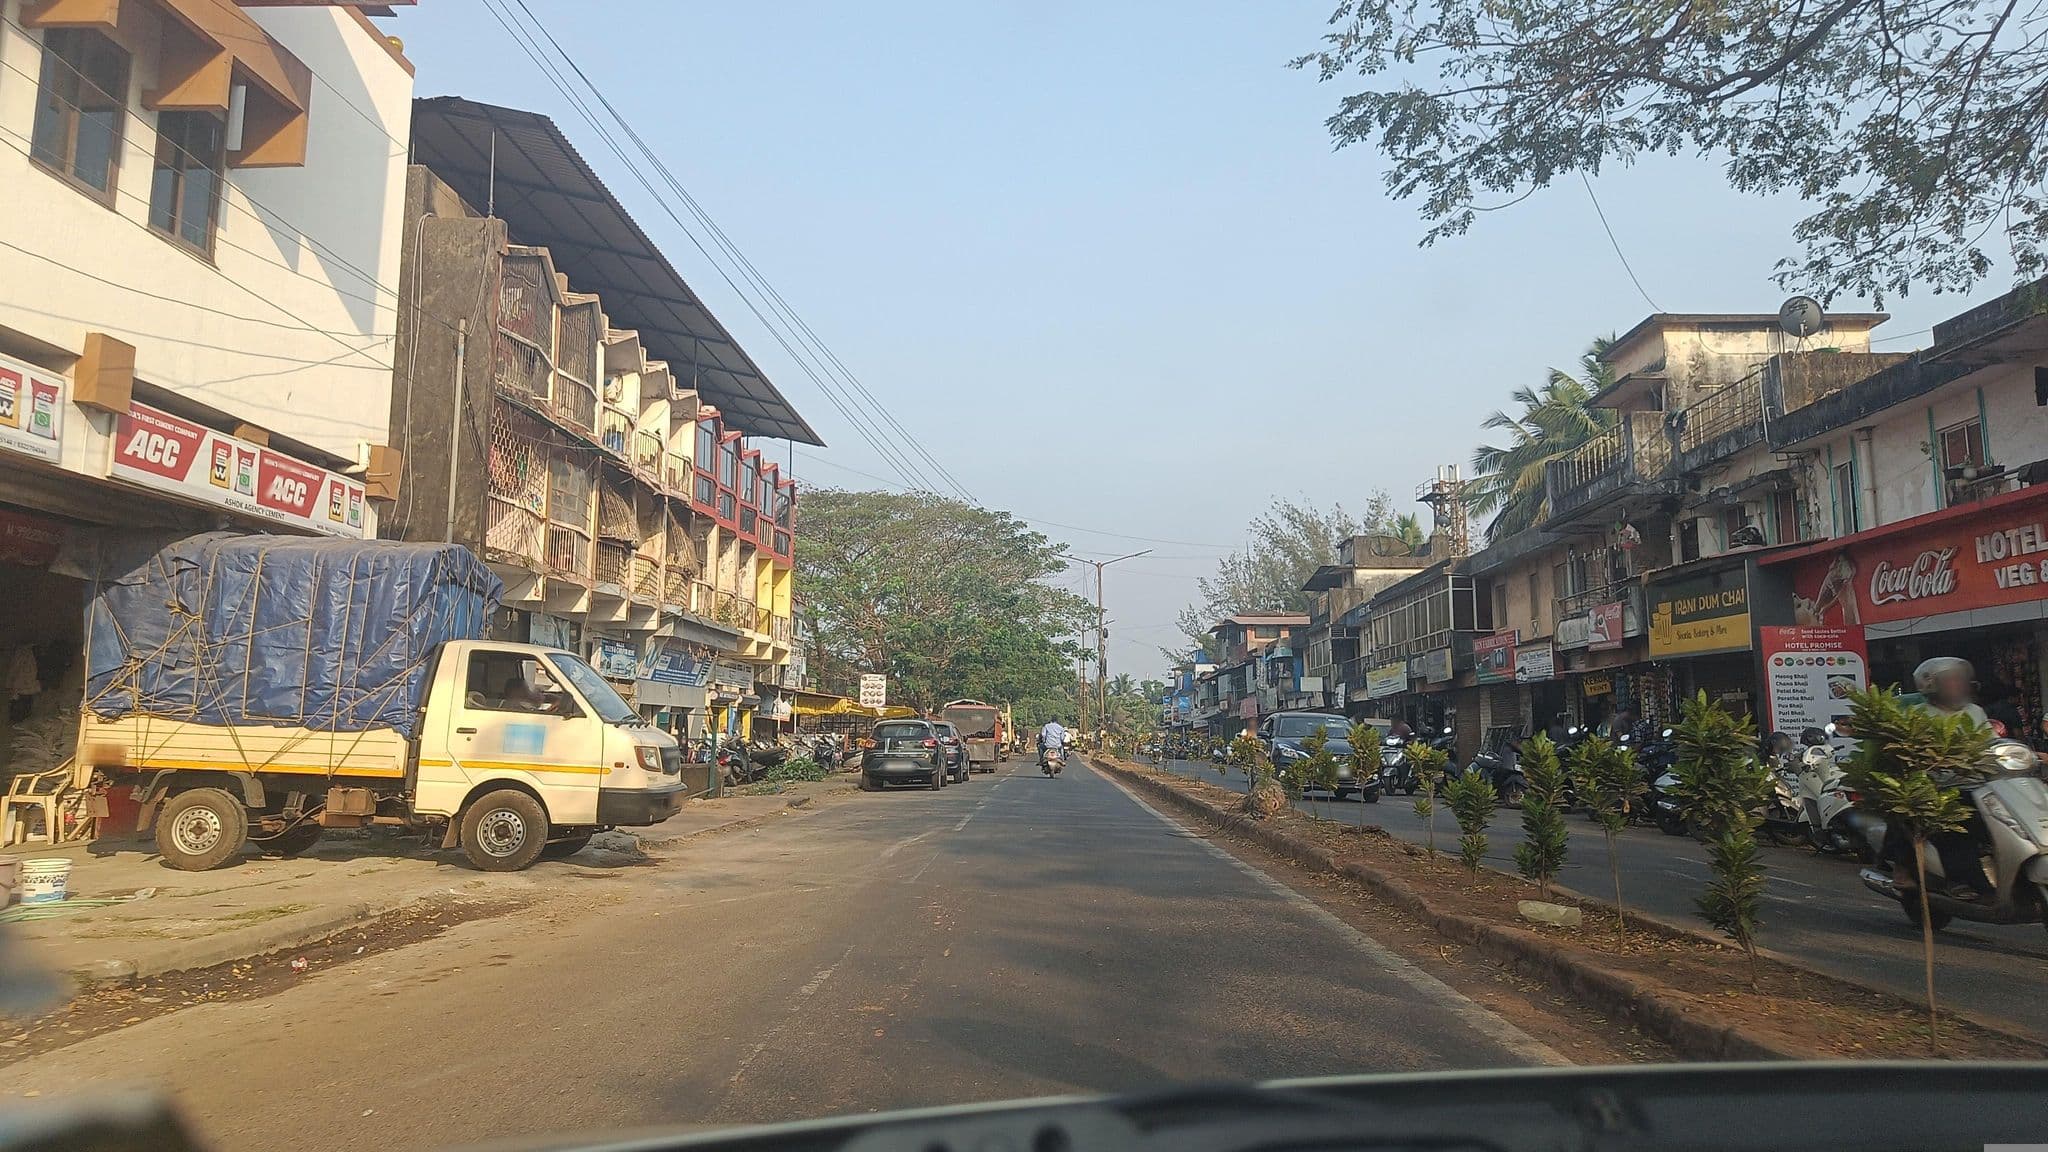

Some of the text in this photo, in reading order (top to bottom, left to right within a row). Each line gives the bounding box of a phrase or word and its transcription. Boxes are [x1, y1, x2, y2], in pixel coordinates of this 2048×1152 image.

[155, 418, 174, 432] CEMENT
[174, 426, 198, 440] COMPANY
[123, 429, 181, 468] ACC
[269, 474, 308, 507] ACC
[224, 498, 286, 520] ASHOK AGENCY CEMENT
[1975, 523, 2048, 564] HOTEL
[1871, 545, 1958, 606] Coca-Cola
[1994, 562, 2037, 589] VEG
[1674, 587, 1745, 616] IRANI DUM CHAI
